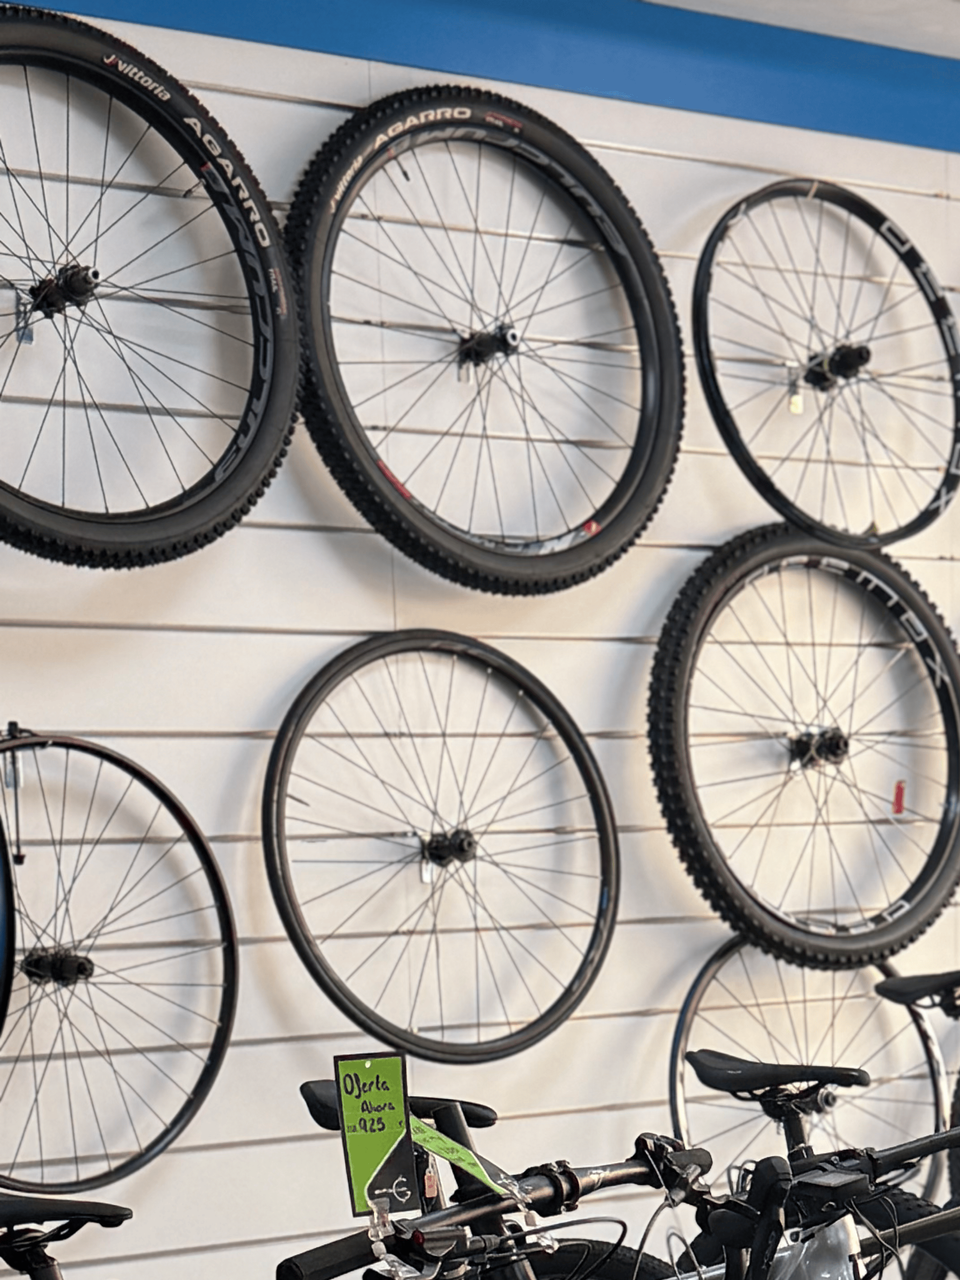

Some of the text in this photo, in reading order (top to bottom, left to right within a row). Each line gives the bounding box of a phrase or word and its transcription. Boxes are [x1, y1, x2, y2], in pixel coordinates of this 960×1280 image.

[373, 107, 472, 149] AGARRO
[183, 117, 271, 248] AGARRO
[343, 1073, 390, 1099] Oferta
[361, 1100, 396, 1114] Ahora
[358, 1117, 386, 1133] 925
